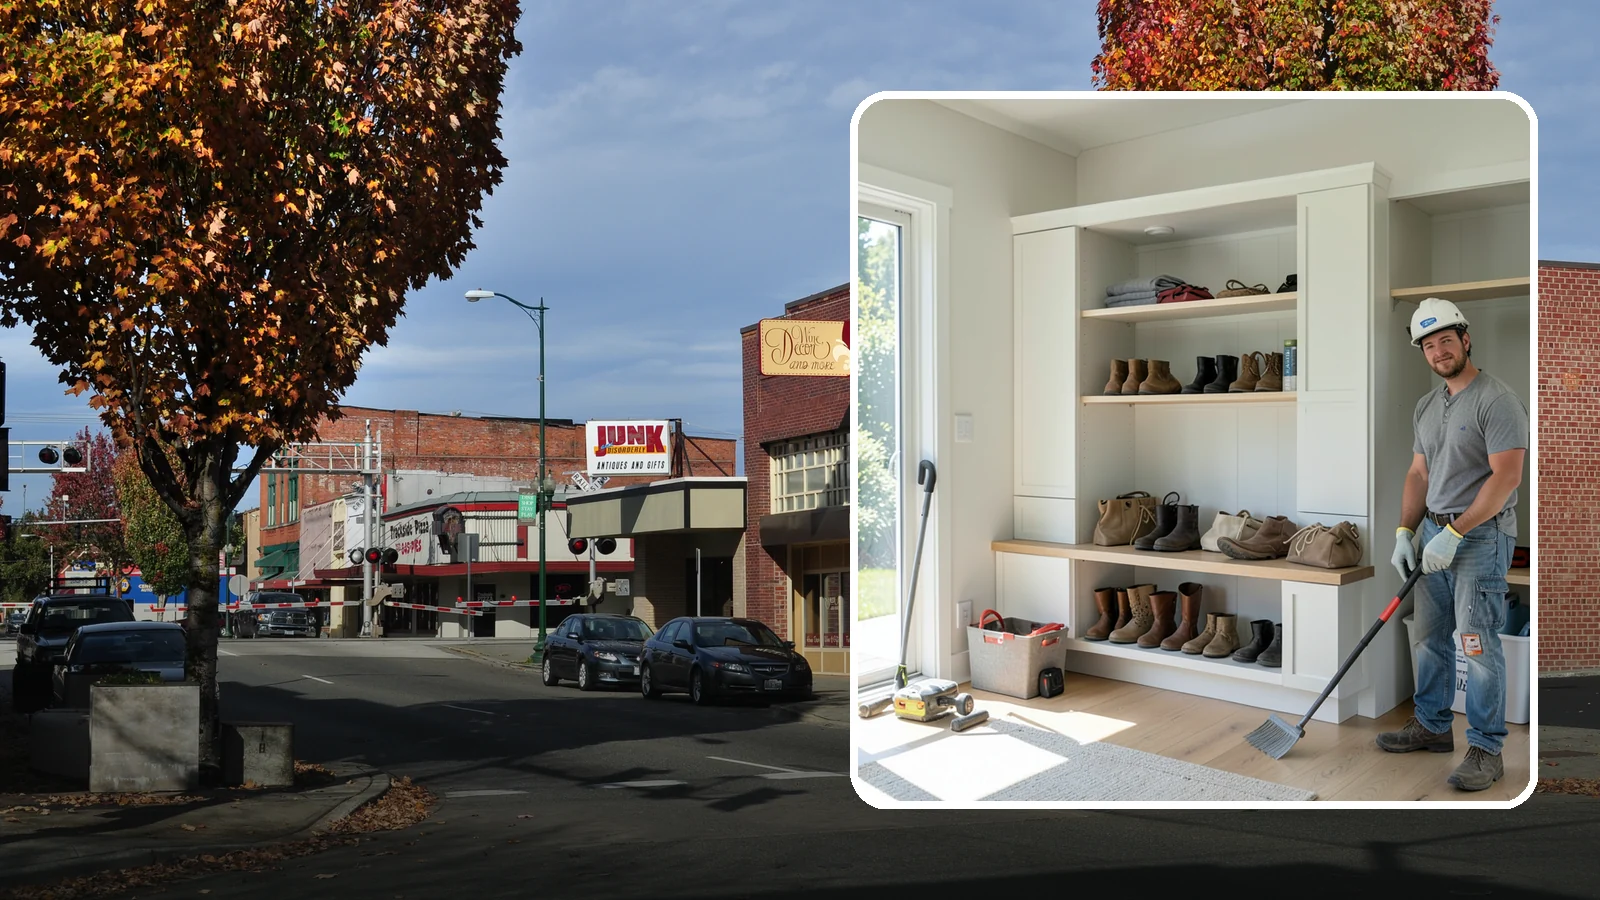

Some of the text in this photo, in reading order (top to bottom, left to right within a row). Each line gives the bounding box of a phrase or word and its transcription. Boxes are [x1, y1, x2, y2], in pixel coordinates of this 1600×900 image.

[595, 425, 665, 457] JUNK
[607, 446, 646, 454] DISORDERLY
[597, 461, 665, 470] ANTIQUES AND GIFTS
[352, 498, 365, 511] CRO
[390, 519, 429, 540] Trackside Pizza
